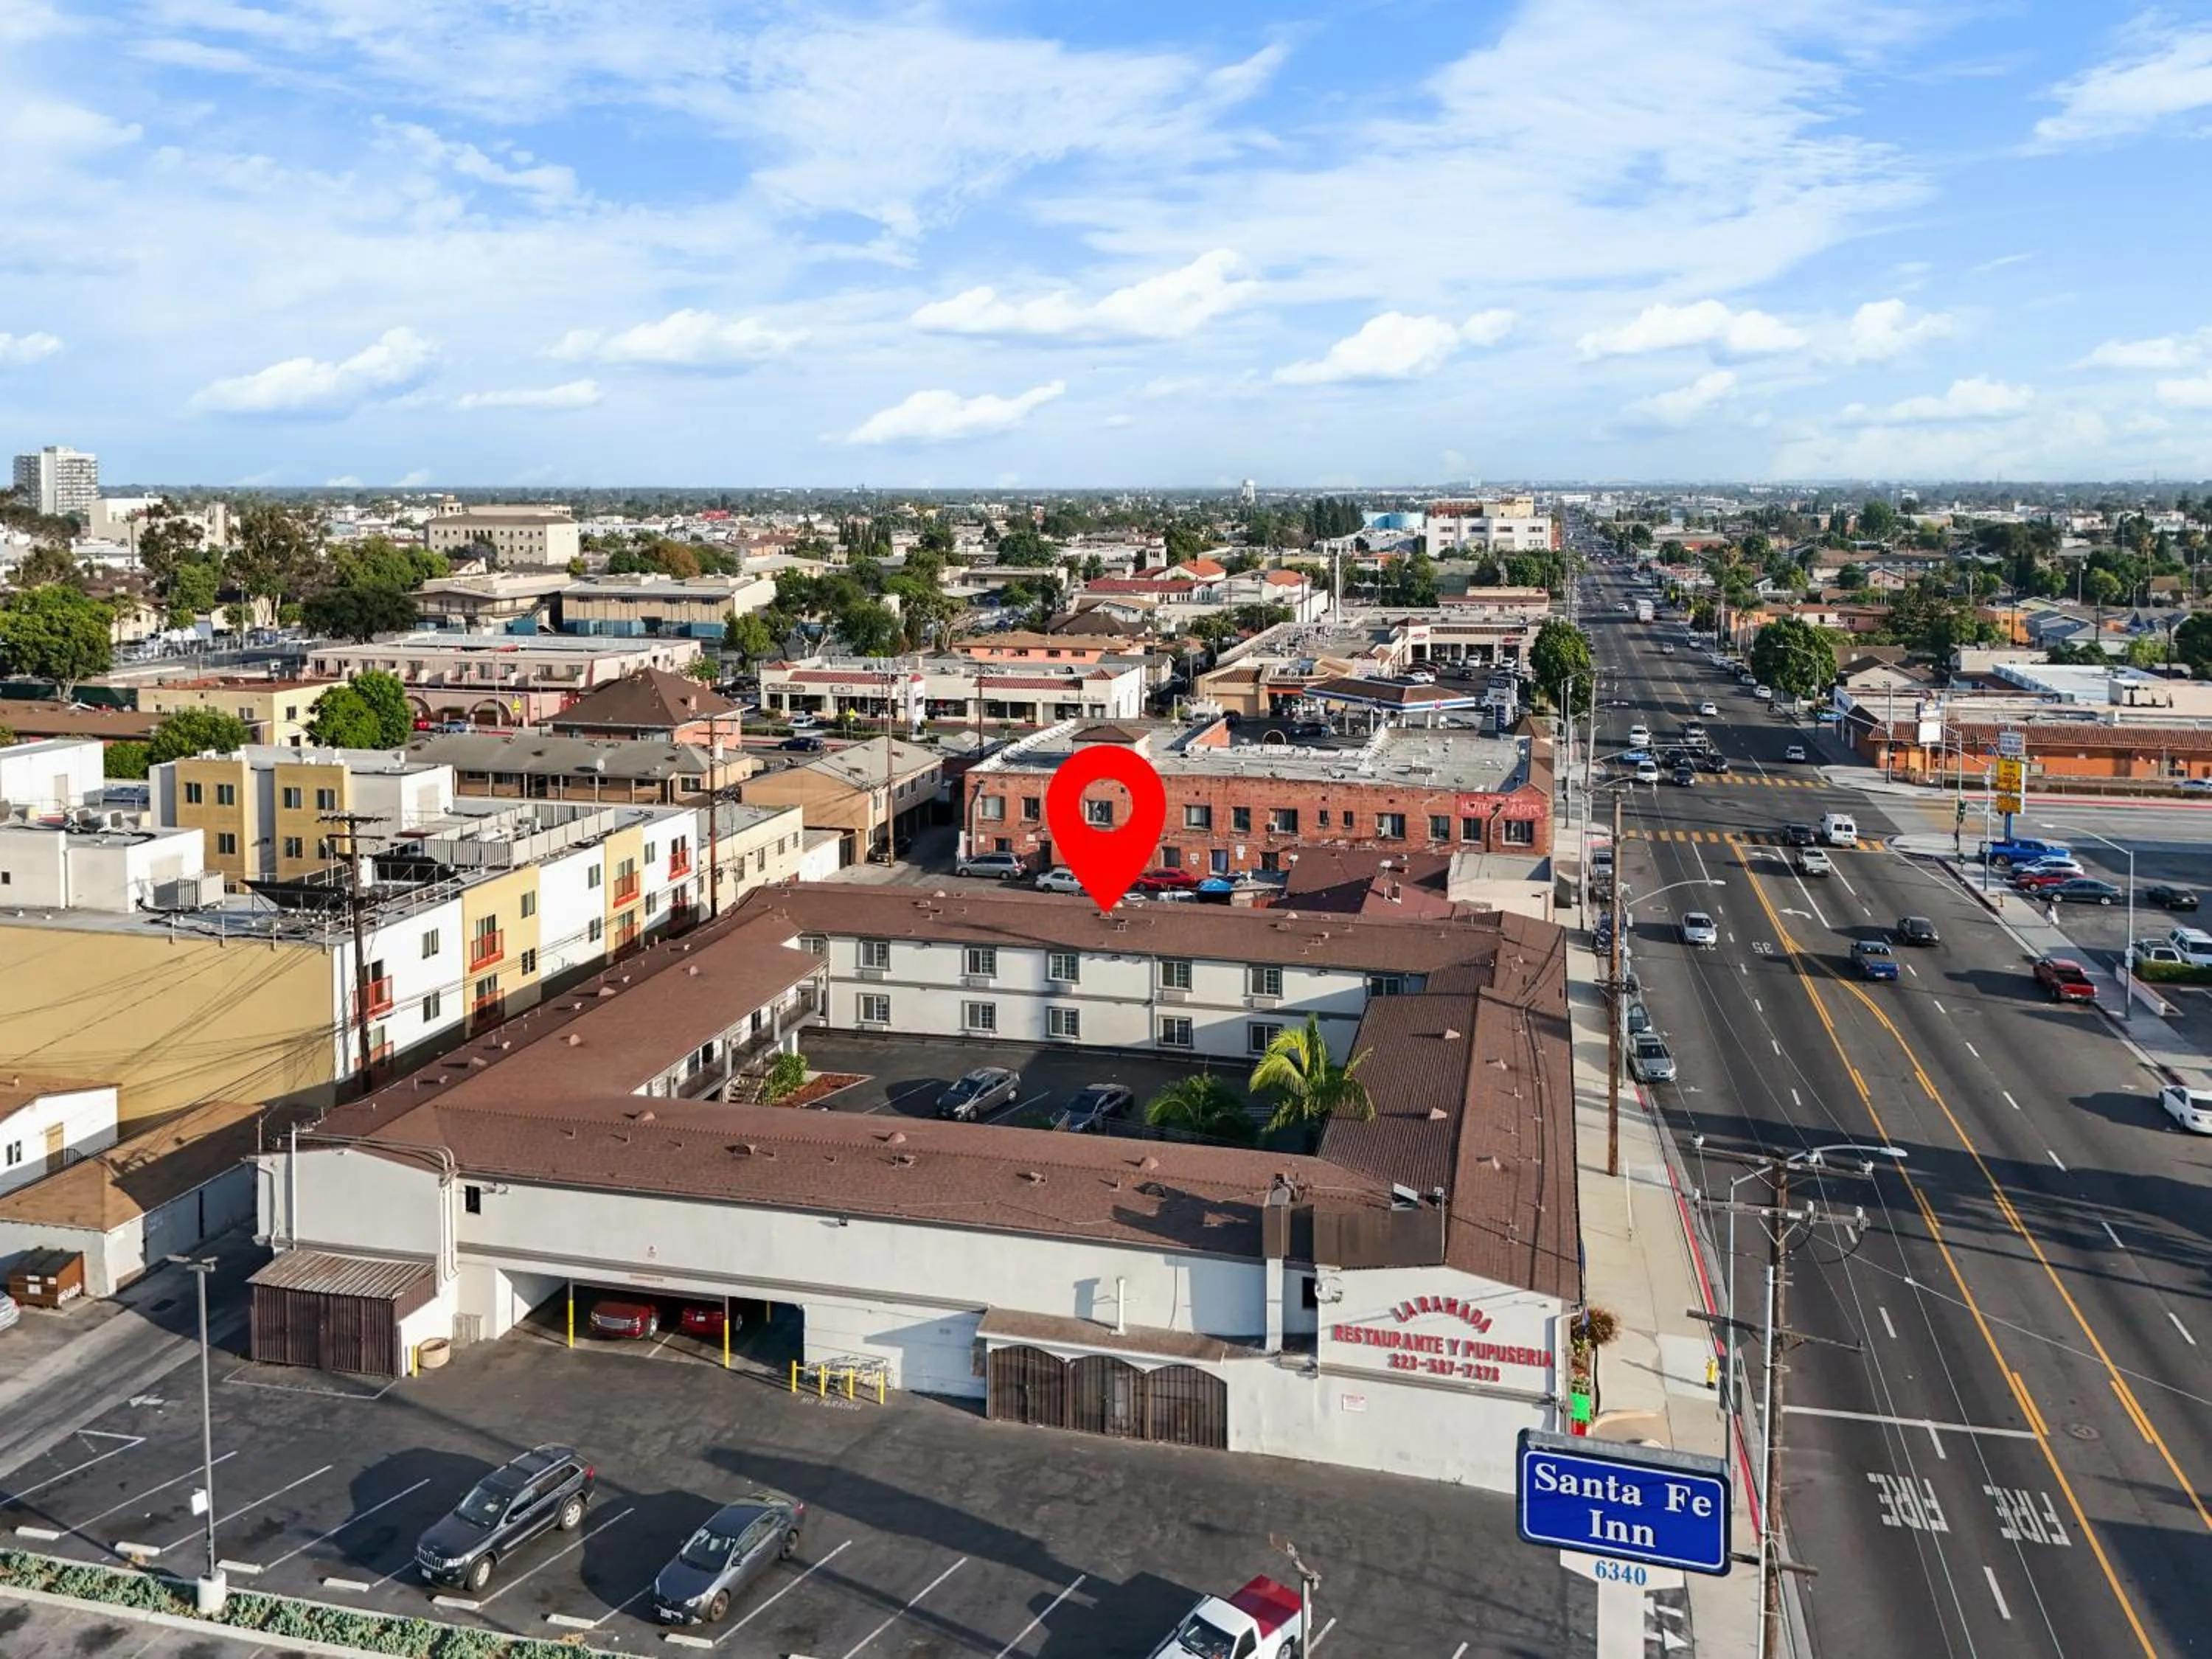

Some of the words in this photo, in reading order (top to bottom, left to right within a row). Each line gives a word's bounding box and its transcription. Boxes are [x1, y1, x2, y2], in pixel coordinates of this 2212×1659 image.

[1389, 1300, 1418, 1323] LA
[1413, 1295, 1493, 1334] RAMADA
[1331, 1324, 1444, 1354] RESTAURANTE
[1445, 1338, 1461, 1356] Y
[1461, 1340, 1554, 1368] PUPUSERIA
[1534, 1462, 1643, 1506] Santa
[1664, 1483, 1712, 1517] Fe
[1866, 1472, 1952, 1534] FIRE
[1589, 1509, 1656, 1548] Inn
[1982, 1484, 2072, 1547] FIRE
[1594, 1559, 1647, 1587] 6340
